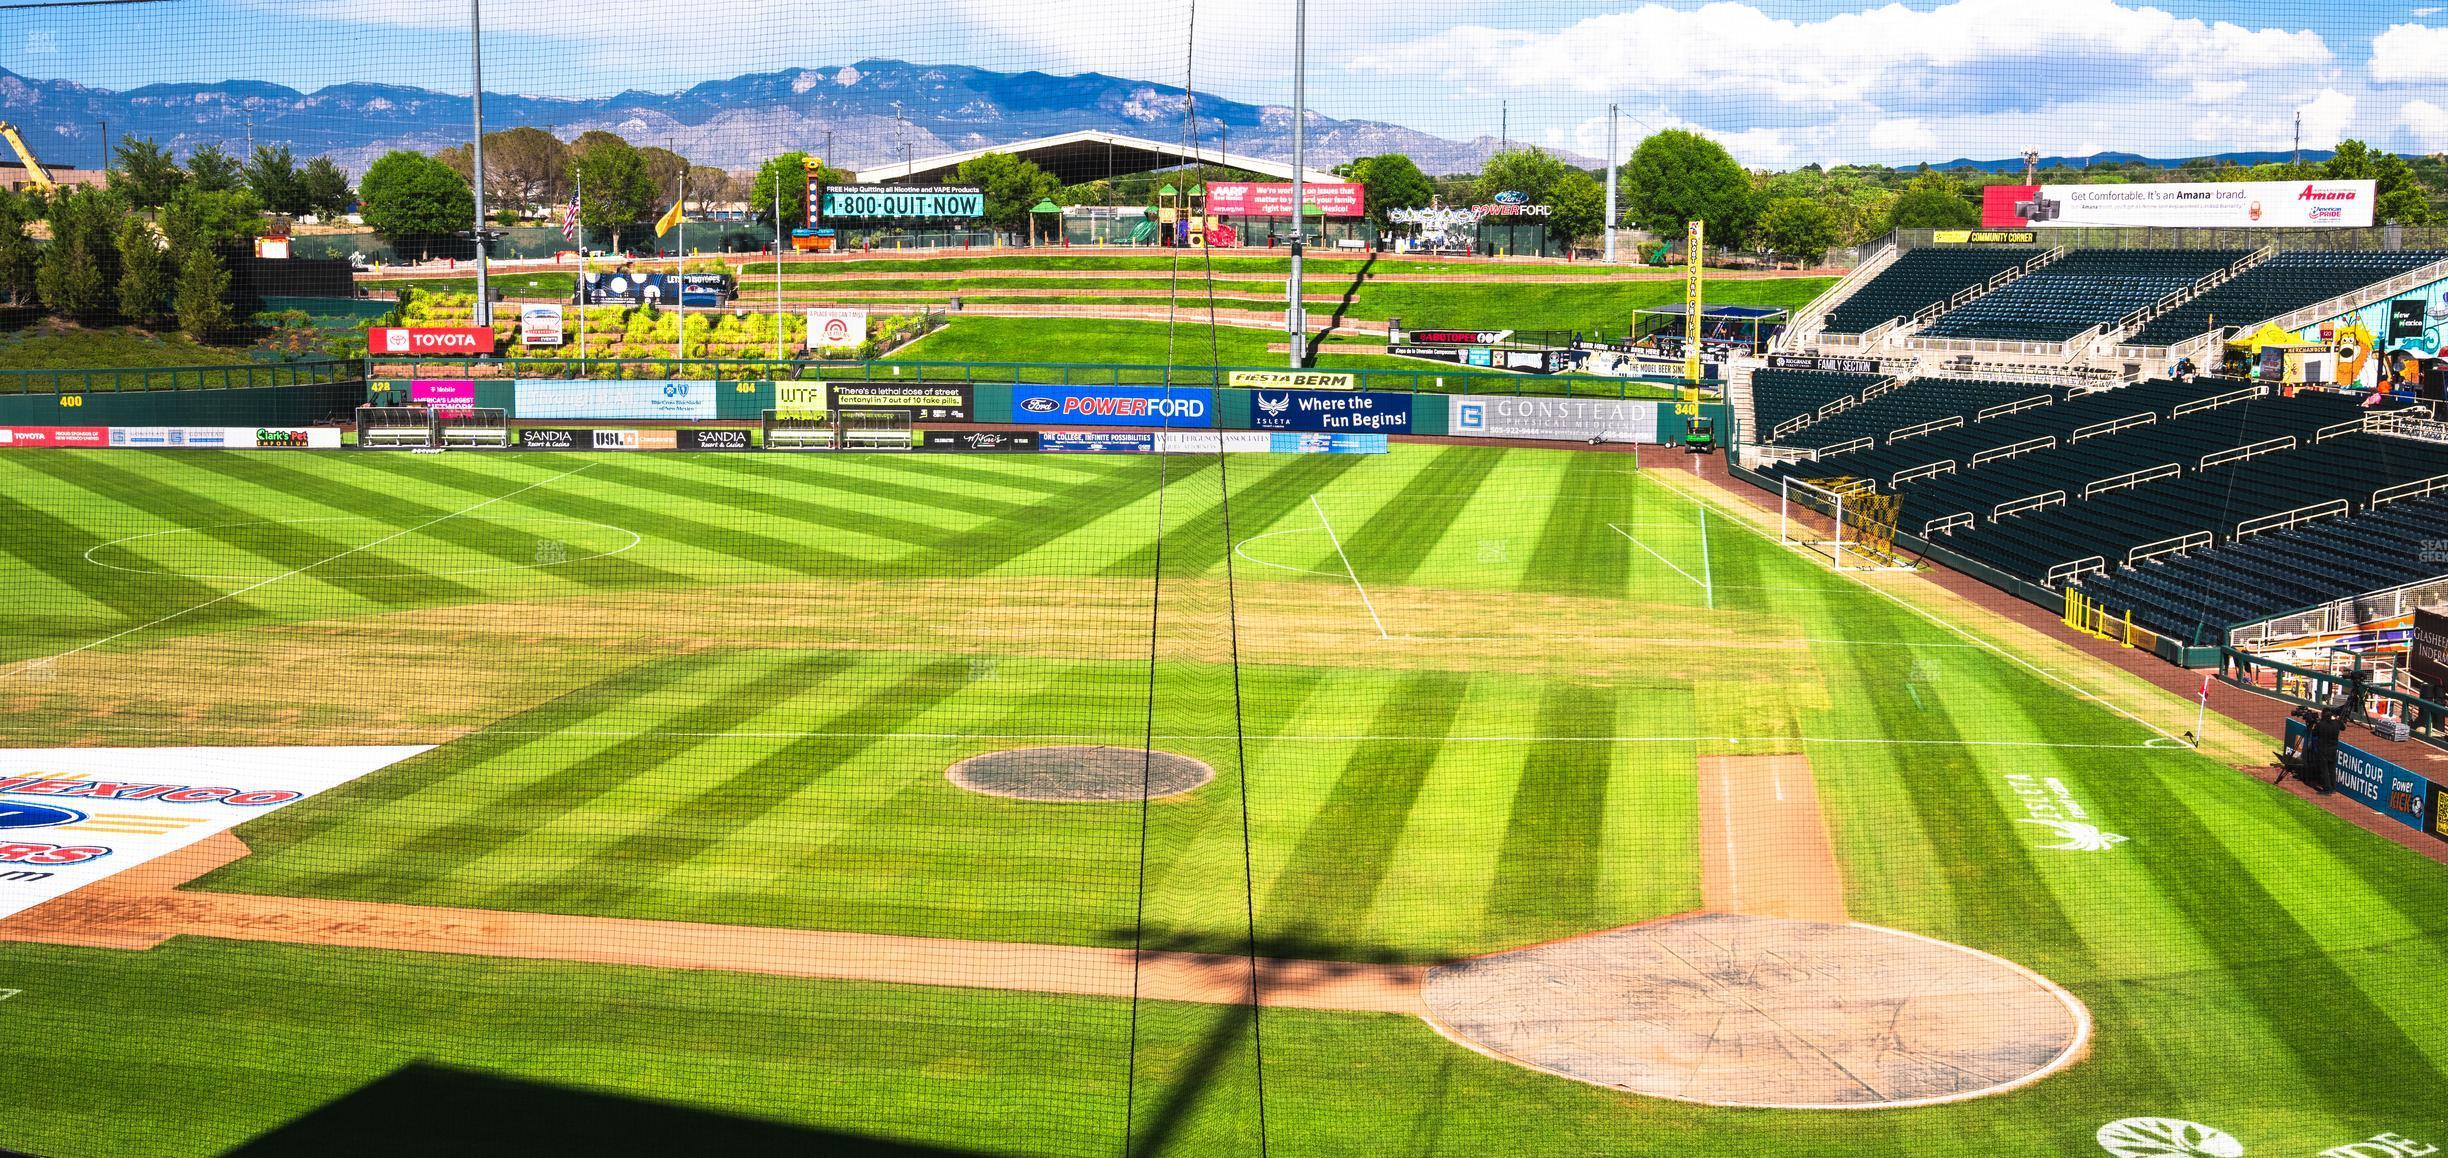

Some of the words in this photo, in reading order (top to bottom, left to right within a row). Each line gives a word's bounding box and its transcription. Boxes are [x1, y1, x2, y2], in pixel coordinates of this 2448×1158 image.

[1257, 187, 1277, 195] We're
[1318, 187, 1339, 195] issues
[1340, 187, 1354, 195] that
[2071, 191, 2086, 201] Get
[2088, 190, 2145, 201] Comfortable.
[2148, 191, 2161, 200] It's
[2216, 189, 2247, 199] brand.
[2297, 184, 2356, 200] Amana
[1334, 197, 1356, 205] family
[1262, 205, 1279, 213] right
[1972, 233, 2008, 242] COMMUNITY
[2008, 233, 2033, 242] CORNER
[413, 334, 476, 346] TOYOTA
[1645, 348, 1660, 356] HERE
[1630, 362, 1639, 372] THE
[1640, 364, 1657, 374] MODEL
[1658, 364, 1672, 374] BEER
[1673, 364, 1685, 374] SINC
[1818, 359, 1842, 370] FAMILY
[1843, 360, 1870, 372] SECTION
[1294, 375, 1347, 386] BERM
[371, 382, 391, 392] 428
[736, 383, 755, 394] 404
[878, 387, 898, 396] lethal
[900, 388, 922, 396] dose
[924, 388, 934, 396] of
[935, 388, 959, 396] street
[781, 388, 817, 402] WTF
[841, 396, 873, 405] fentanyl
[903, 397, 912, 405] of
[913, 397, 921, 405] 10
[922, 397, 940, 405] fake
[941, 397, 960, 406] pills.
[59, 395, 82, 408] 400
[1026, 400, 1052, 411] Ford
[1298, 397, 1346, 412] Where
[1348, 395, 1373, 409] the
[1498, 400, 1646, 421] GONSTEAD
[1674, 404, 1695, 416] 340
[1323, 414, 1349, 428] Fun
[1352, 412, 1406, 429] Begins!
[1506, 417, 1567, 428] PHYSICAL
[14, 432, 46, 440] TOYOTA
[256, 428, 289, 440] Clark's
[291, 430, 308, 441] Pet
[524, 431, 572, 442] SANDIA
[698, 431, 746, 443] SANDIA
[1057, 434, 1084, 442] COLLEGE,
[1111, 434, 1151, 442] POSSIBILITIES
[2413, 626, 2448, 648] GLASHEE
[2336, 749, 2363, 775] ERING
[2365, 764, 2384, 784] OUR
[2335, 768, 2379, 801] MUNITIES
[2392, 777, 2414, 793] Power
[2390, 791, 2412, 813] KICK
